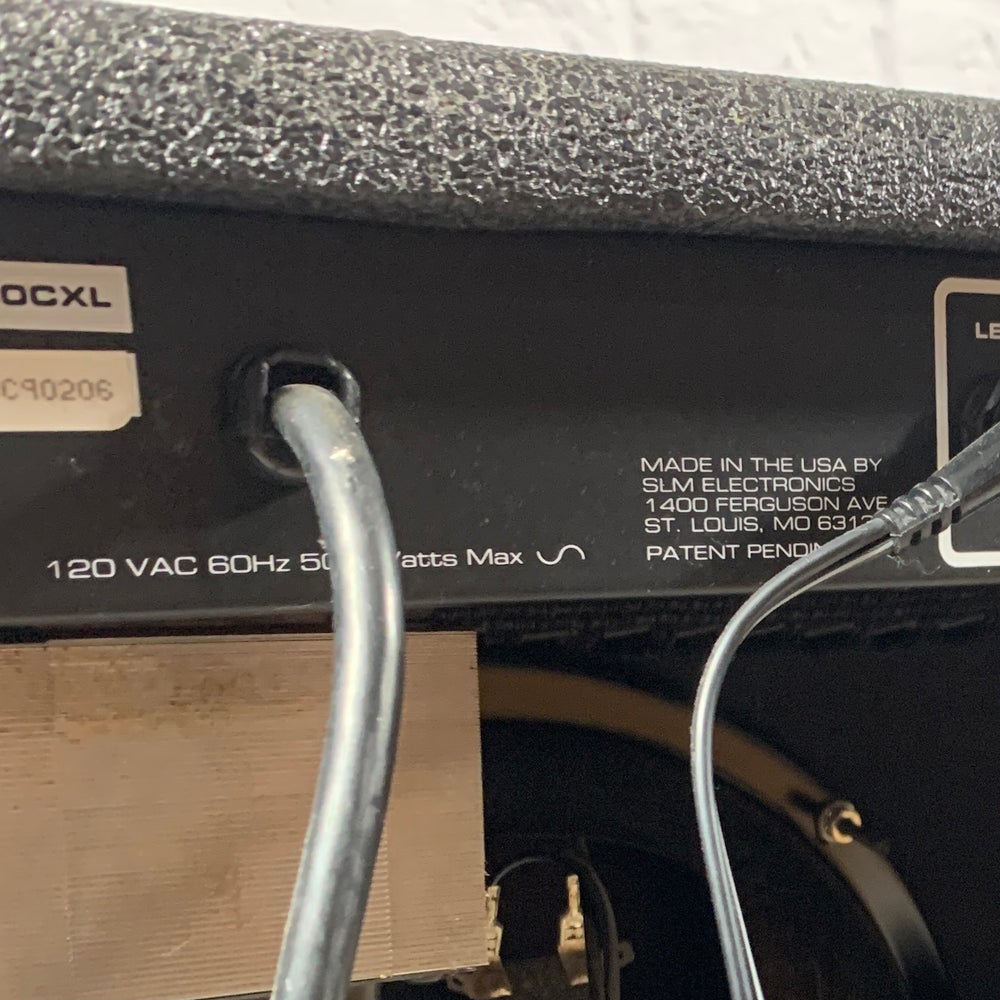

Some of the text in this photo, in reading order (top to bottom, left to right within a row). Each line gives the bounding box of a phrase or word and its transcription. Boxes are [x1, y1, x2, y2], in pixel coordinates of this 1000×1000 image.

[641, 457, 882, 473] MADE IN THE USA BY
[642, 477, 856, 493] SLM ELECTRONICS
[645, 496, 888, 513] 1400 FERGUSON AVE
[644, 515, 875, 534] ST. LOUIS, MO 631
[646, 544, 739, 561] PATENT
[46, 558, 115, 579] 120
[125, 555, 198, 577] VAC
[207, 553, 291, 575] 60Hz
[395, 550, 458, 569] atts
[466, 547, 524, 567] Max
